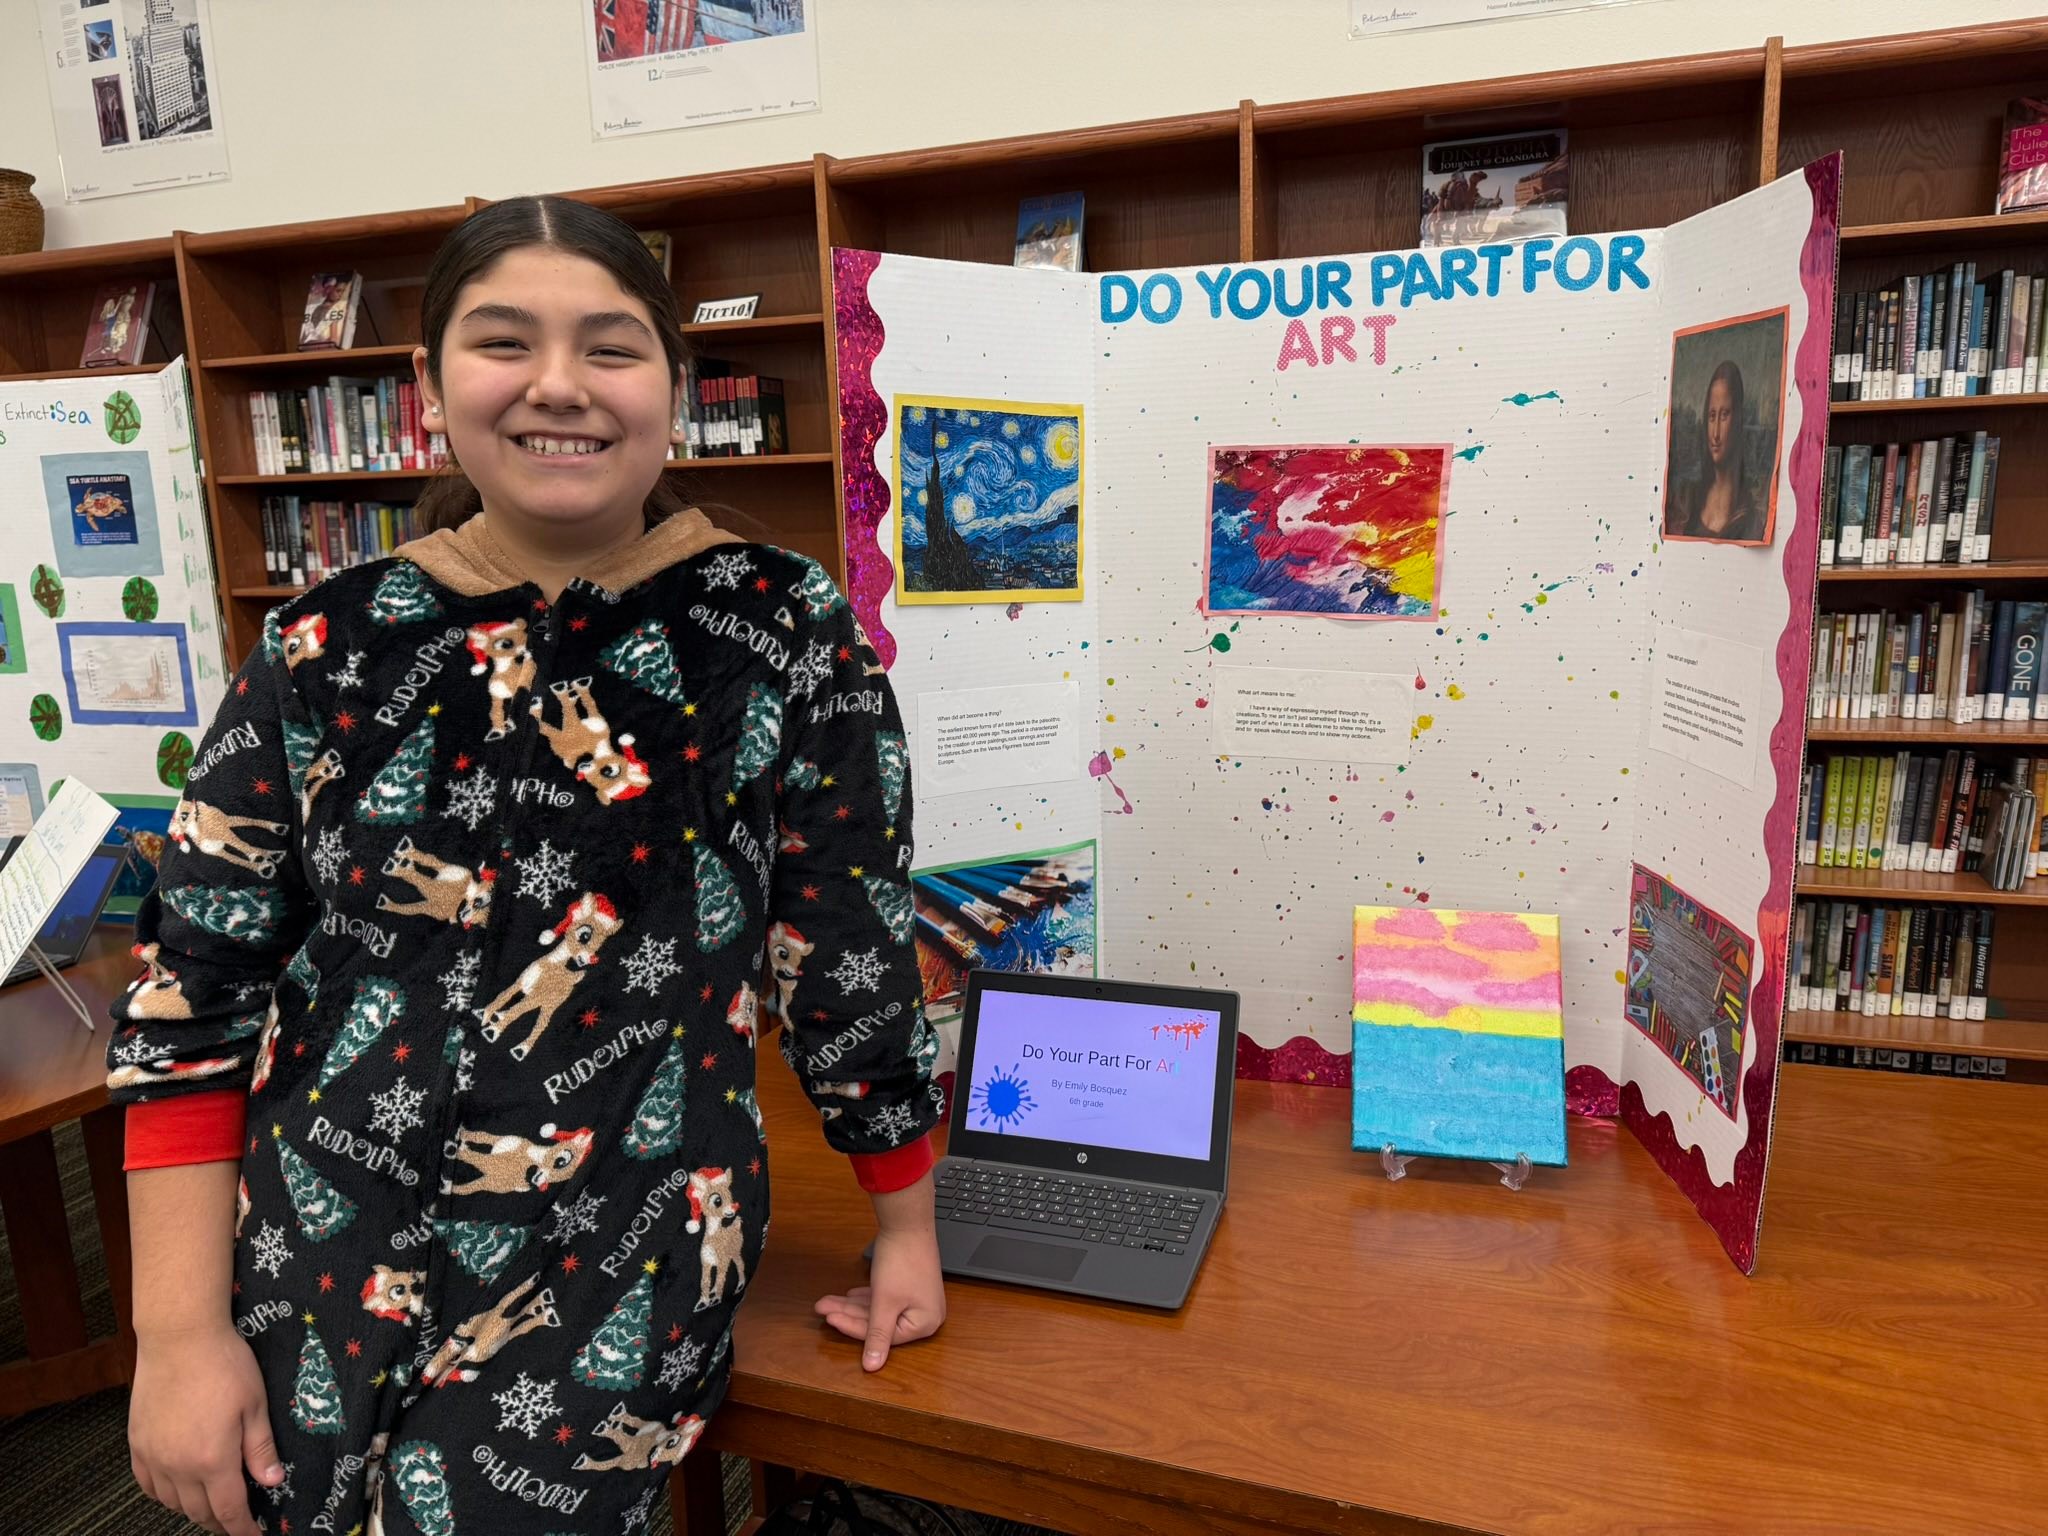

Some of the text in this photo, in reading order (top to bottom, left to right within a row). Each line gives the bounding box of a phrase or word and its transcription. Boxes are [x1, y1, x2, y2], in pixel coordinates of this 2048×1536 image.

[2011, 128, 2042, 139] The
[1440, 158, 1481, 171] JOURNEY
[1494, 151, 1549, 165] CHANDARA
[2009, 152, 2046, 166] Club
[1100, 235, 1650, 324] DO YOUR PART FOR
[697, 299, 757, 322] FICTION
[1277, 314, 1397, 371] ART
[69, 477, 80, 485] SEA
[99, 475, 127, 484] ANATOMY
[1880, 472, 1895, 538] BLOOD BROTHERS
[1916, 494, 1930, 527] RASH
[2012, 634, 2036, 692] GONE
[988, 710, 1002, 718] thing?
[1290, 707, 1319, 715] expressing
[1338, 710, 1359, 718] through
[1309, 716, 1336, 724] something
[962, 732, 978, 740] 40,000
[1010, 727, 1024, 735] period
[1250, 719, 1260, 727] part
[1364, 726, 1386, 734] feelings
[1967, 756, 1976, 772] JACK
[1827, 796, 1837, 825] HOO
[1843, 796, 1855, 825] HOO
[1860, 796, 1872, 825] HOO
[1953, 813, 1964, 837] SURE
[1880, 953, 1893, 979] SLAM
[1974, 944, 1987, 990] NIGHTRISE
[1022, 1043, 1180, 1074] Do Your Part For Art
[1051, 1078, 1127, 1097] By Emily Bosquez
[1069, 1096, 1104, 1110] 6th grade
